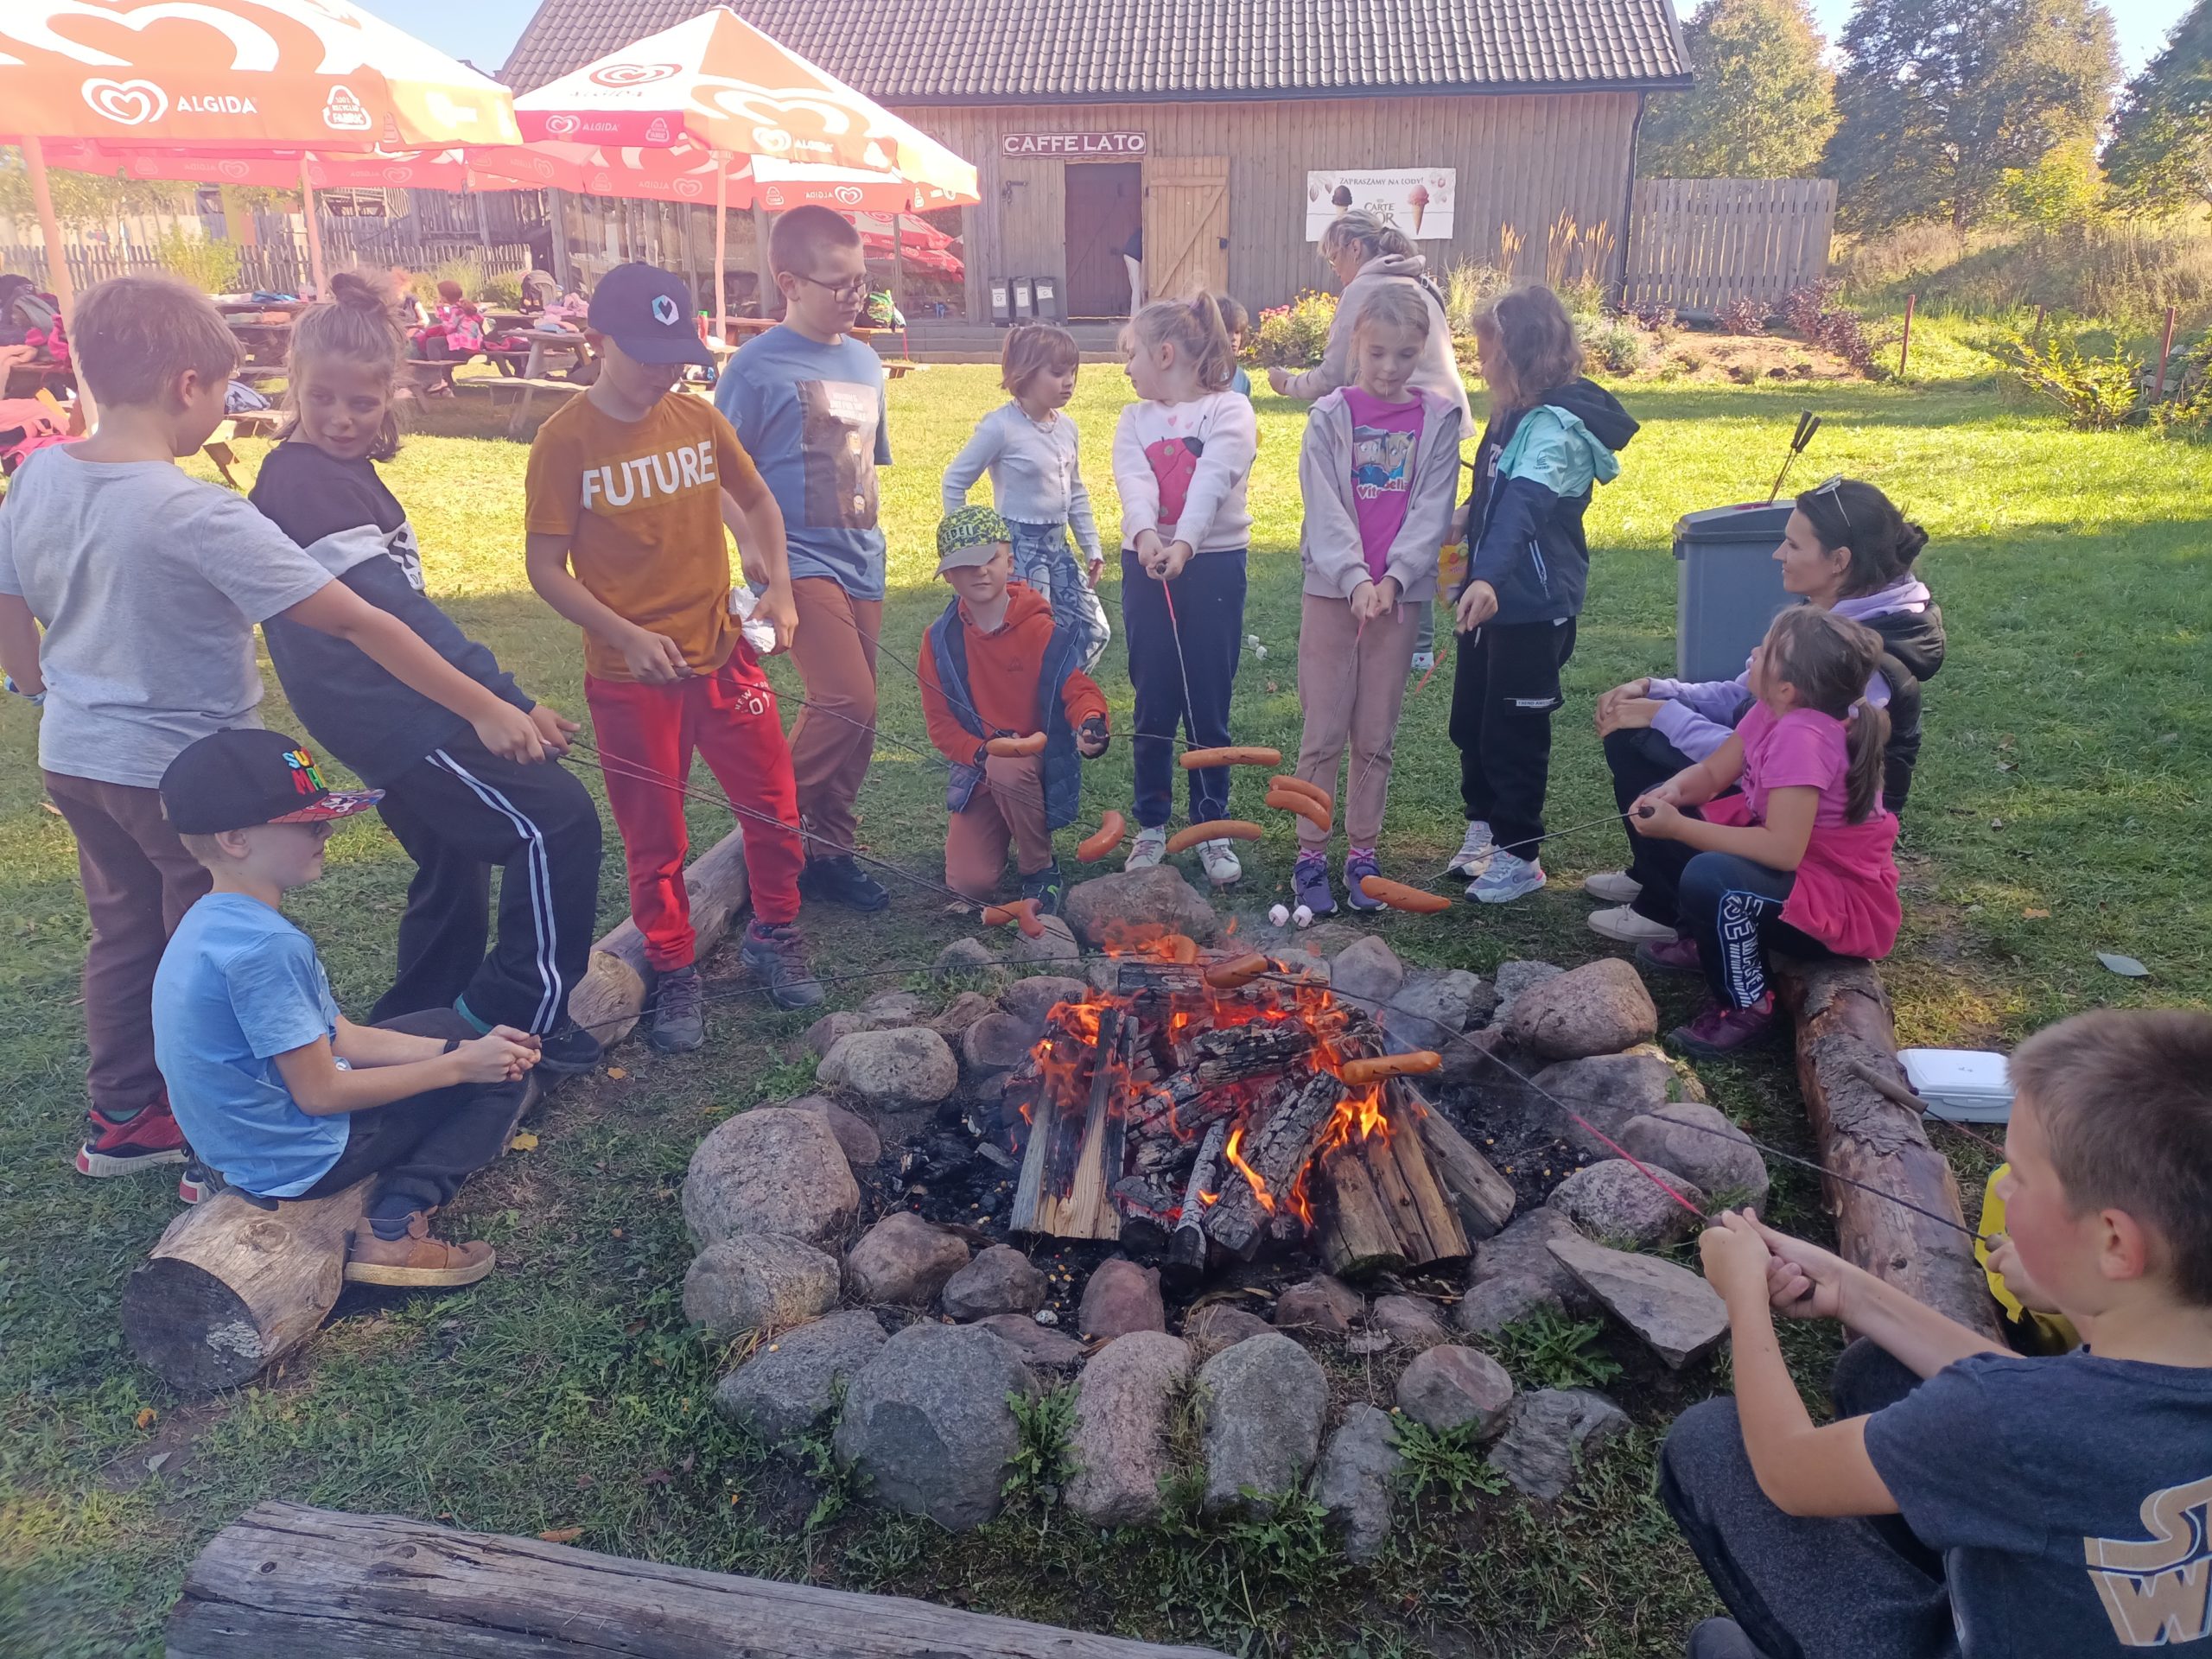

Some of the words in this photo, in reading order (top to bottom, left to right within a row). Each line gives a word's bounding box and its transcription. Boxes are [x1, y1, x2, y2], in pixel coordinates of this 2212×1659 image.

[176, 96, 257, 114] ALGIDA
[582, 123, 619, 131] ALGIDA
[1004, 136, 1079, 152] CAFFE
[1084, 134, 1145, 151] LATO
[1364, 202, 1395, 211] CARTE
[582, 441, 716, 509] FUTURE
[942, 524, 972, 545] REBEL
